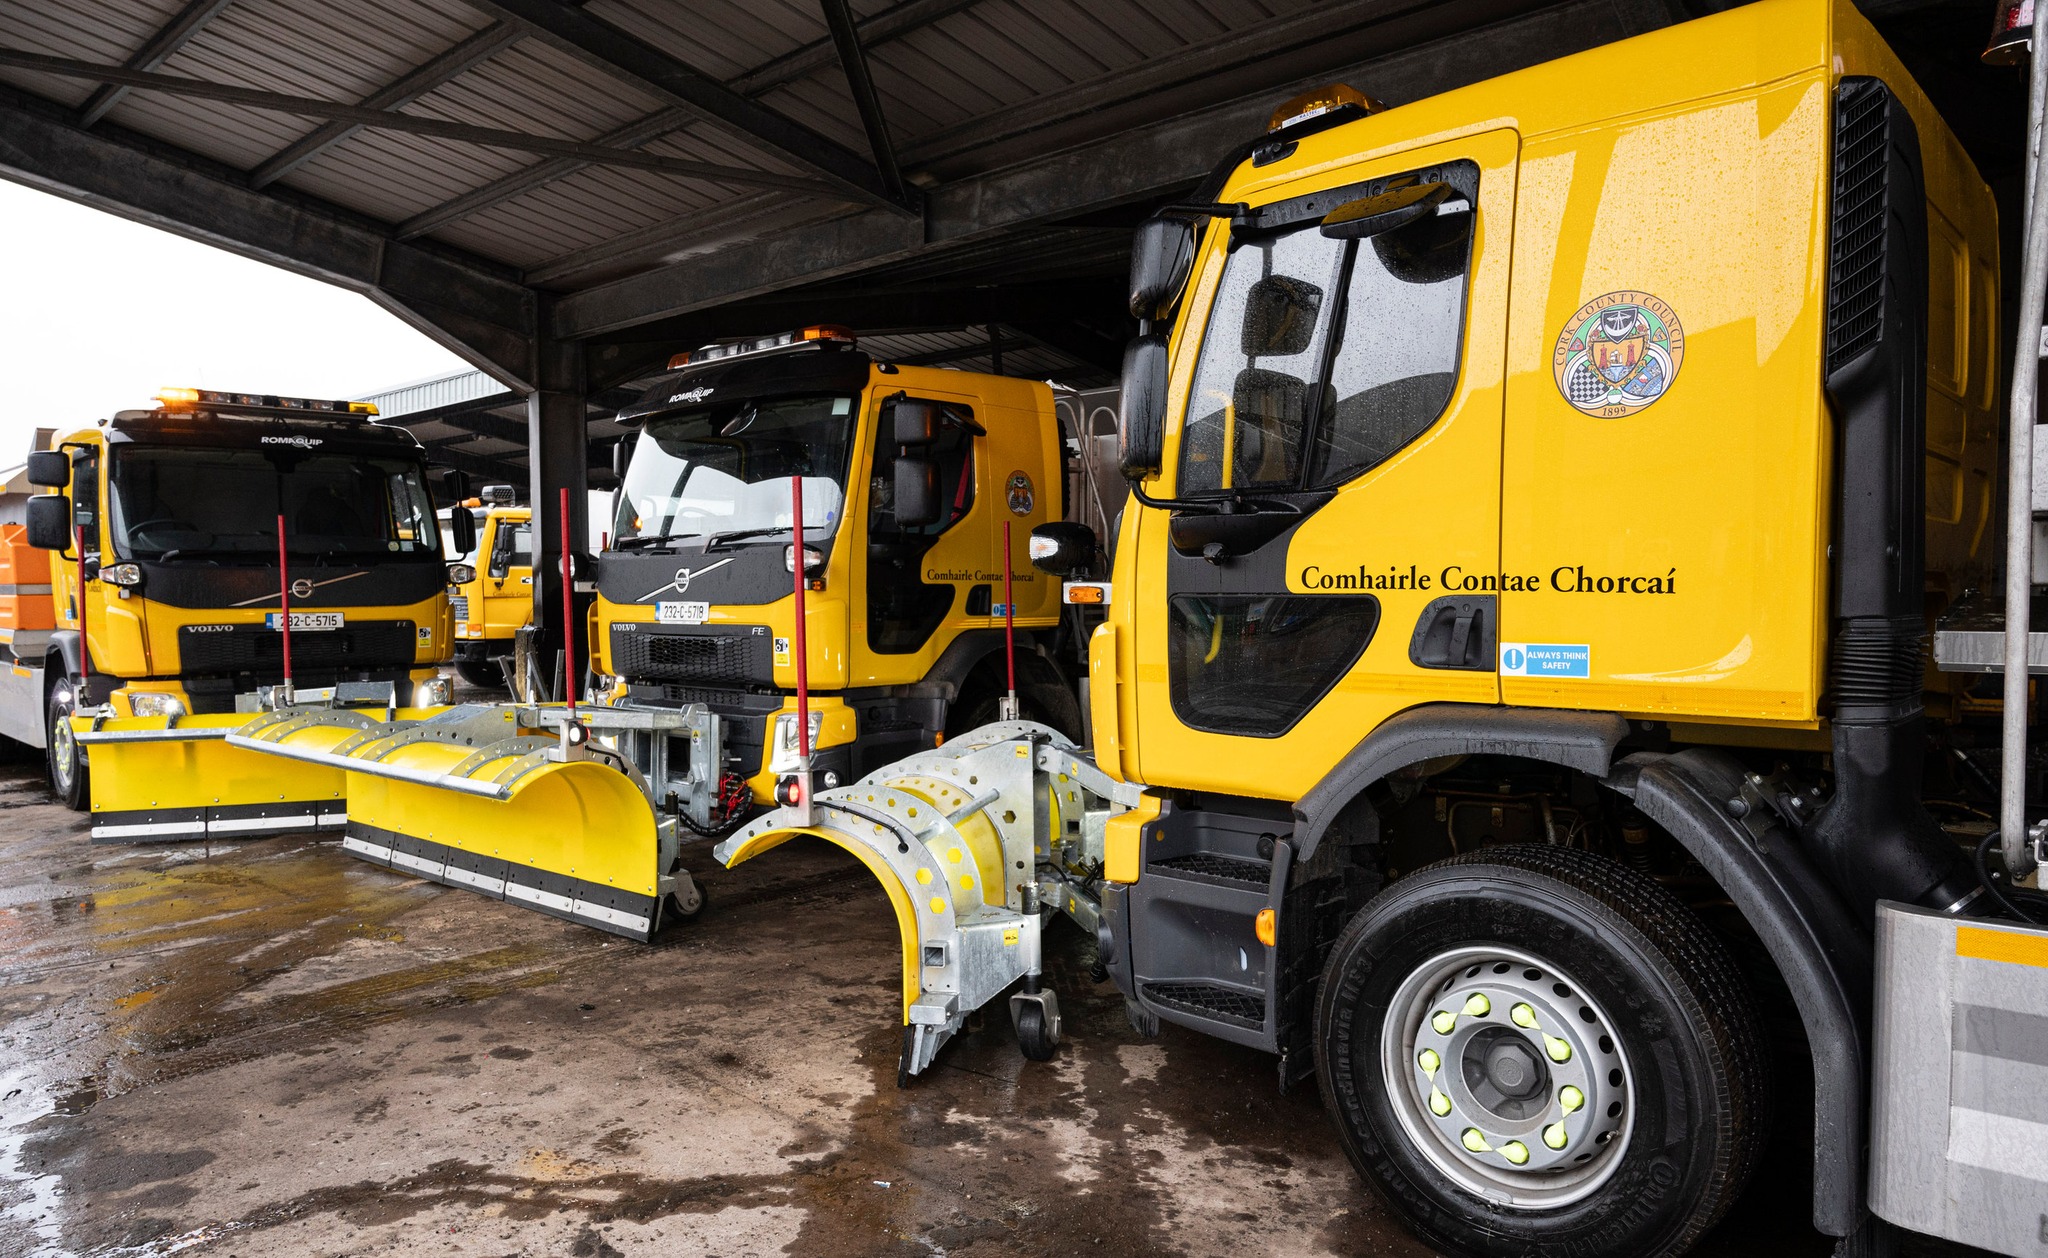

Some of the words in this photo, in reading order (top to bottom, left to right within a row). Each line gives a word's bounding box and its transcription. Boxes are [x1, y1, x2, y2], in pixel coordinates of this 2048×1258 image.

[1556, 327, 1575, 366] CORK
[1577, 293, 1637, 322] COUNTY
[1644, 297, 1683, 352] COUNCIL
[669, 386, 714, 403] ROMAQUIP
[1602, 407, 1626, 416] 1899
[261, 435, 323, 449] ROMAQUIP
[927, 569, 972, 581] Comhairle
[974, 570, 1003, 581] Contae
[1301, 565, 1431, 589] Comhairle
[1440, 565, 1540, 592] Contae
[1550, 565, 1676, 594] Chorcaí
[664, 605, 704, 619] 232-C-5718
[187, 624, 234, 633] VOLVO
[612, 624, 636, 632] VOLVO
[752, 627, 765, 636] FE
[1527, 651, 1561, 660] ALWAYS
[1563, 652, 1587, 660] THINK
[1542, 661, 1571, 670] SAFETY
